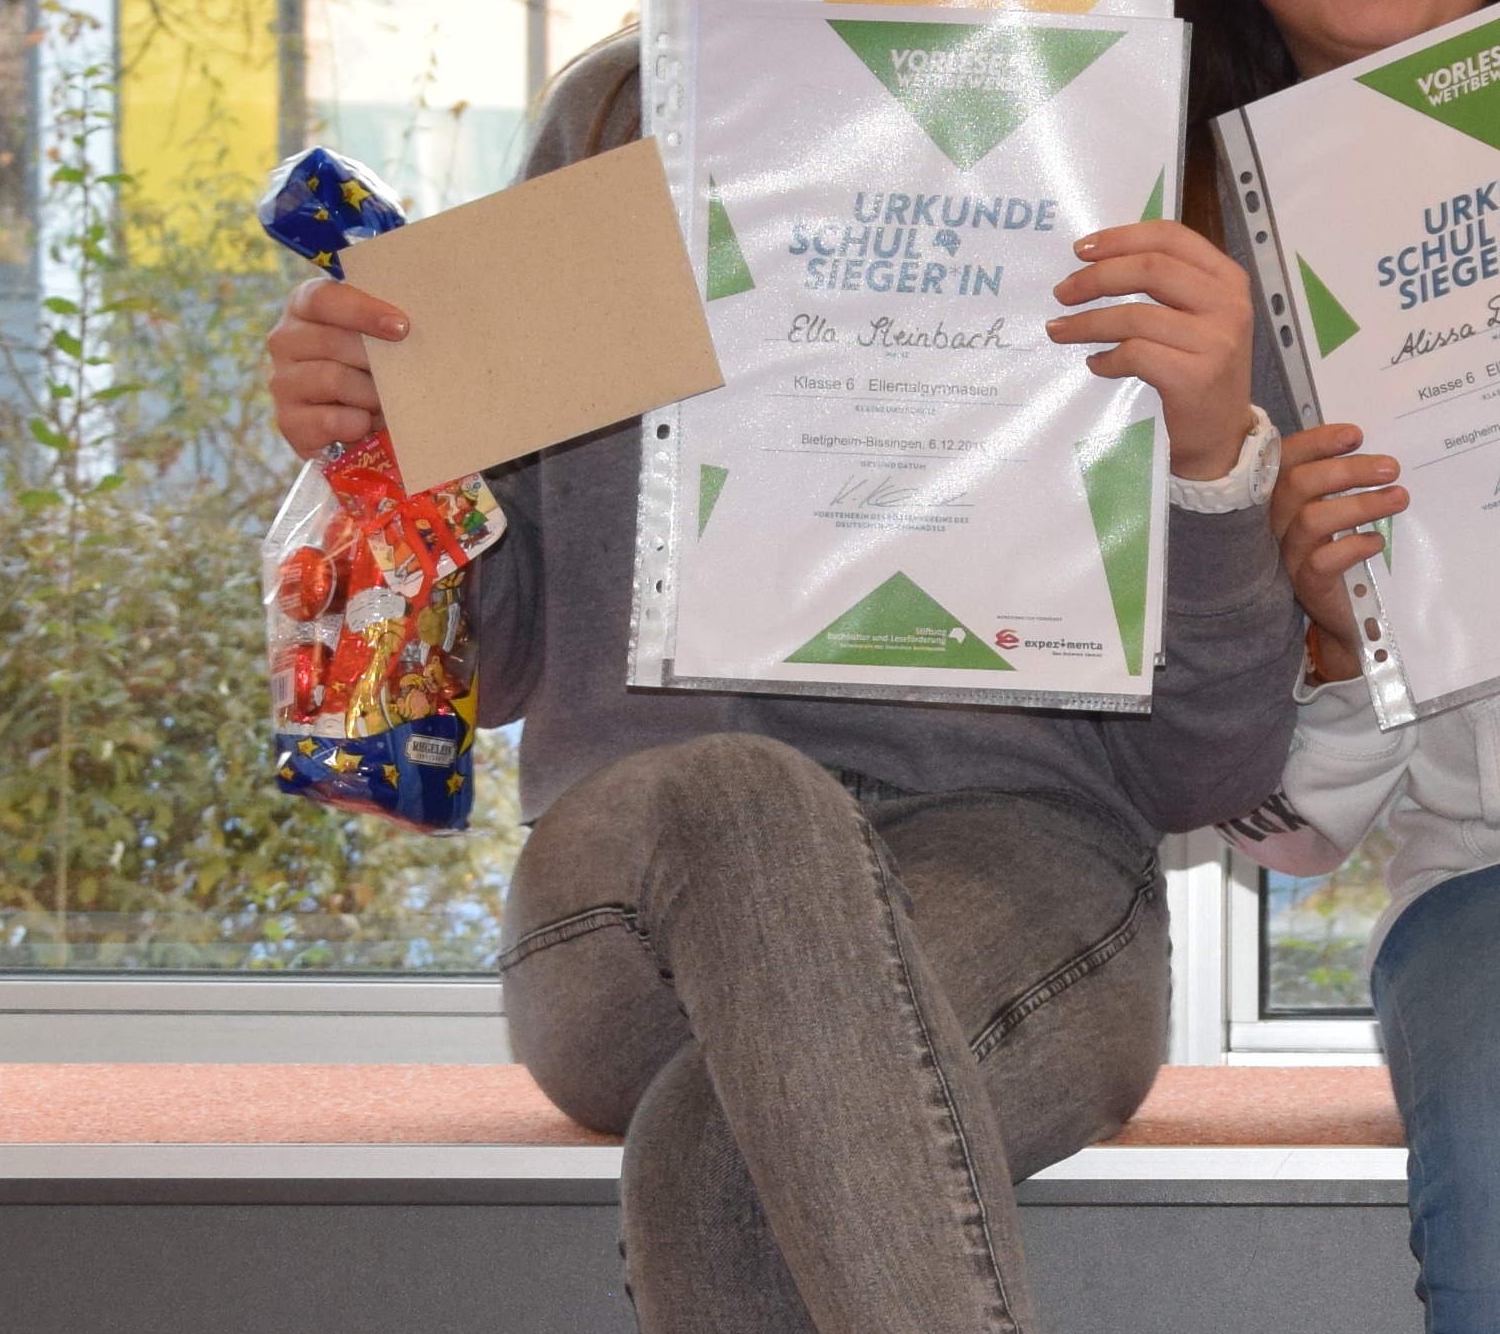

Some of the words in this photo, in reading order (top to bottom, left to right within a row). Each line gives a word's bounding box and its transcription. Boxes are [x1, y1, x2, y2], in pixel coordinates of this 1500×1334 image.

[890, 48, 1003, 74] VORLESE
[854, 191, 1058, 231] URKUNDE
[789, 223, 922, 259] SCHUL
[1377, 218, 1495, 287] SCHUL
[787, 313, 836, 344] Ella
[857, 316, 1011, 350] Steinbach
[1391, 323, 1476, 365] Alissa
[794, 375, 841, 390] Klasse
[846, 378, 854, 391] 6
[1417, 378, 1464, 401] Klasse
[1466, 372, 1475, 384] 6
[1024, 638, 1103, 650] experimenta
